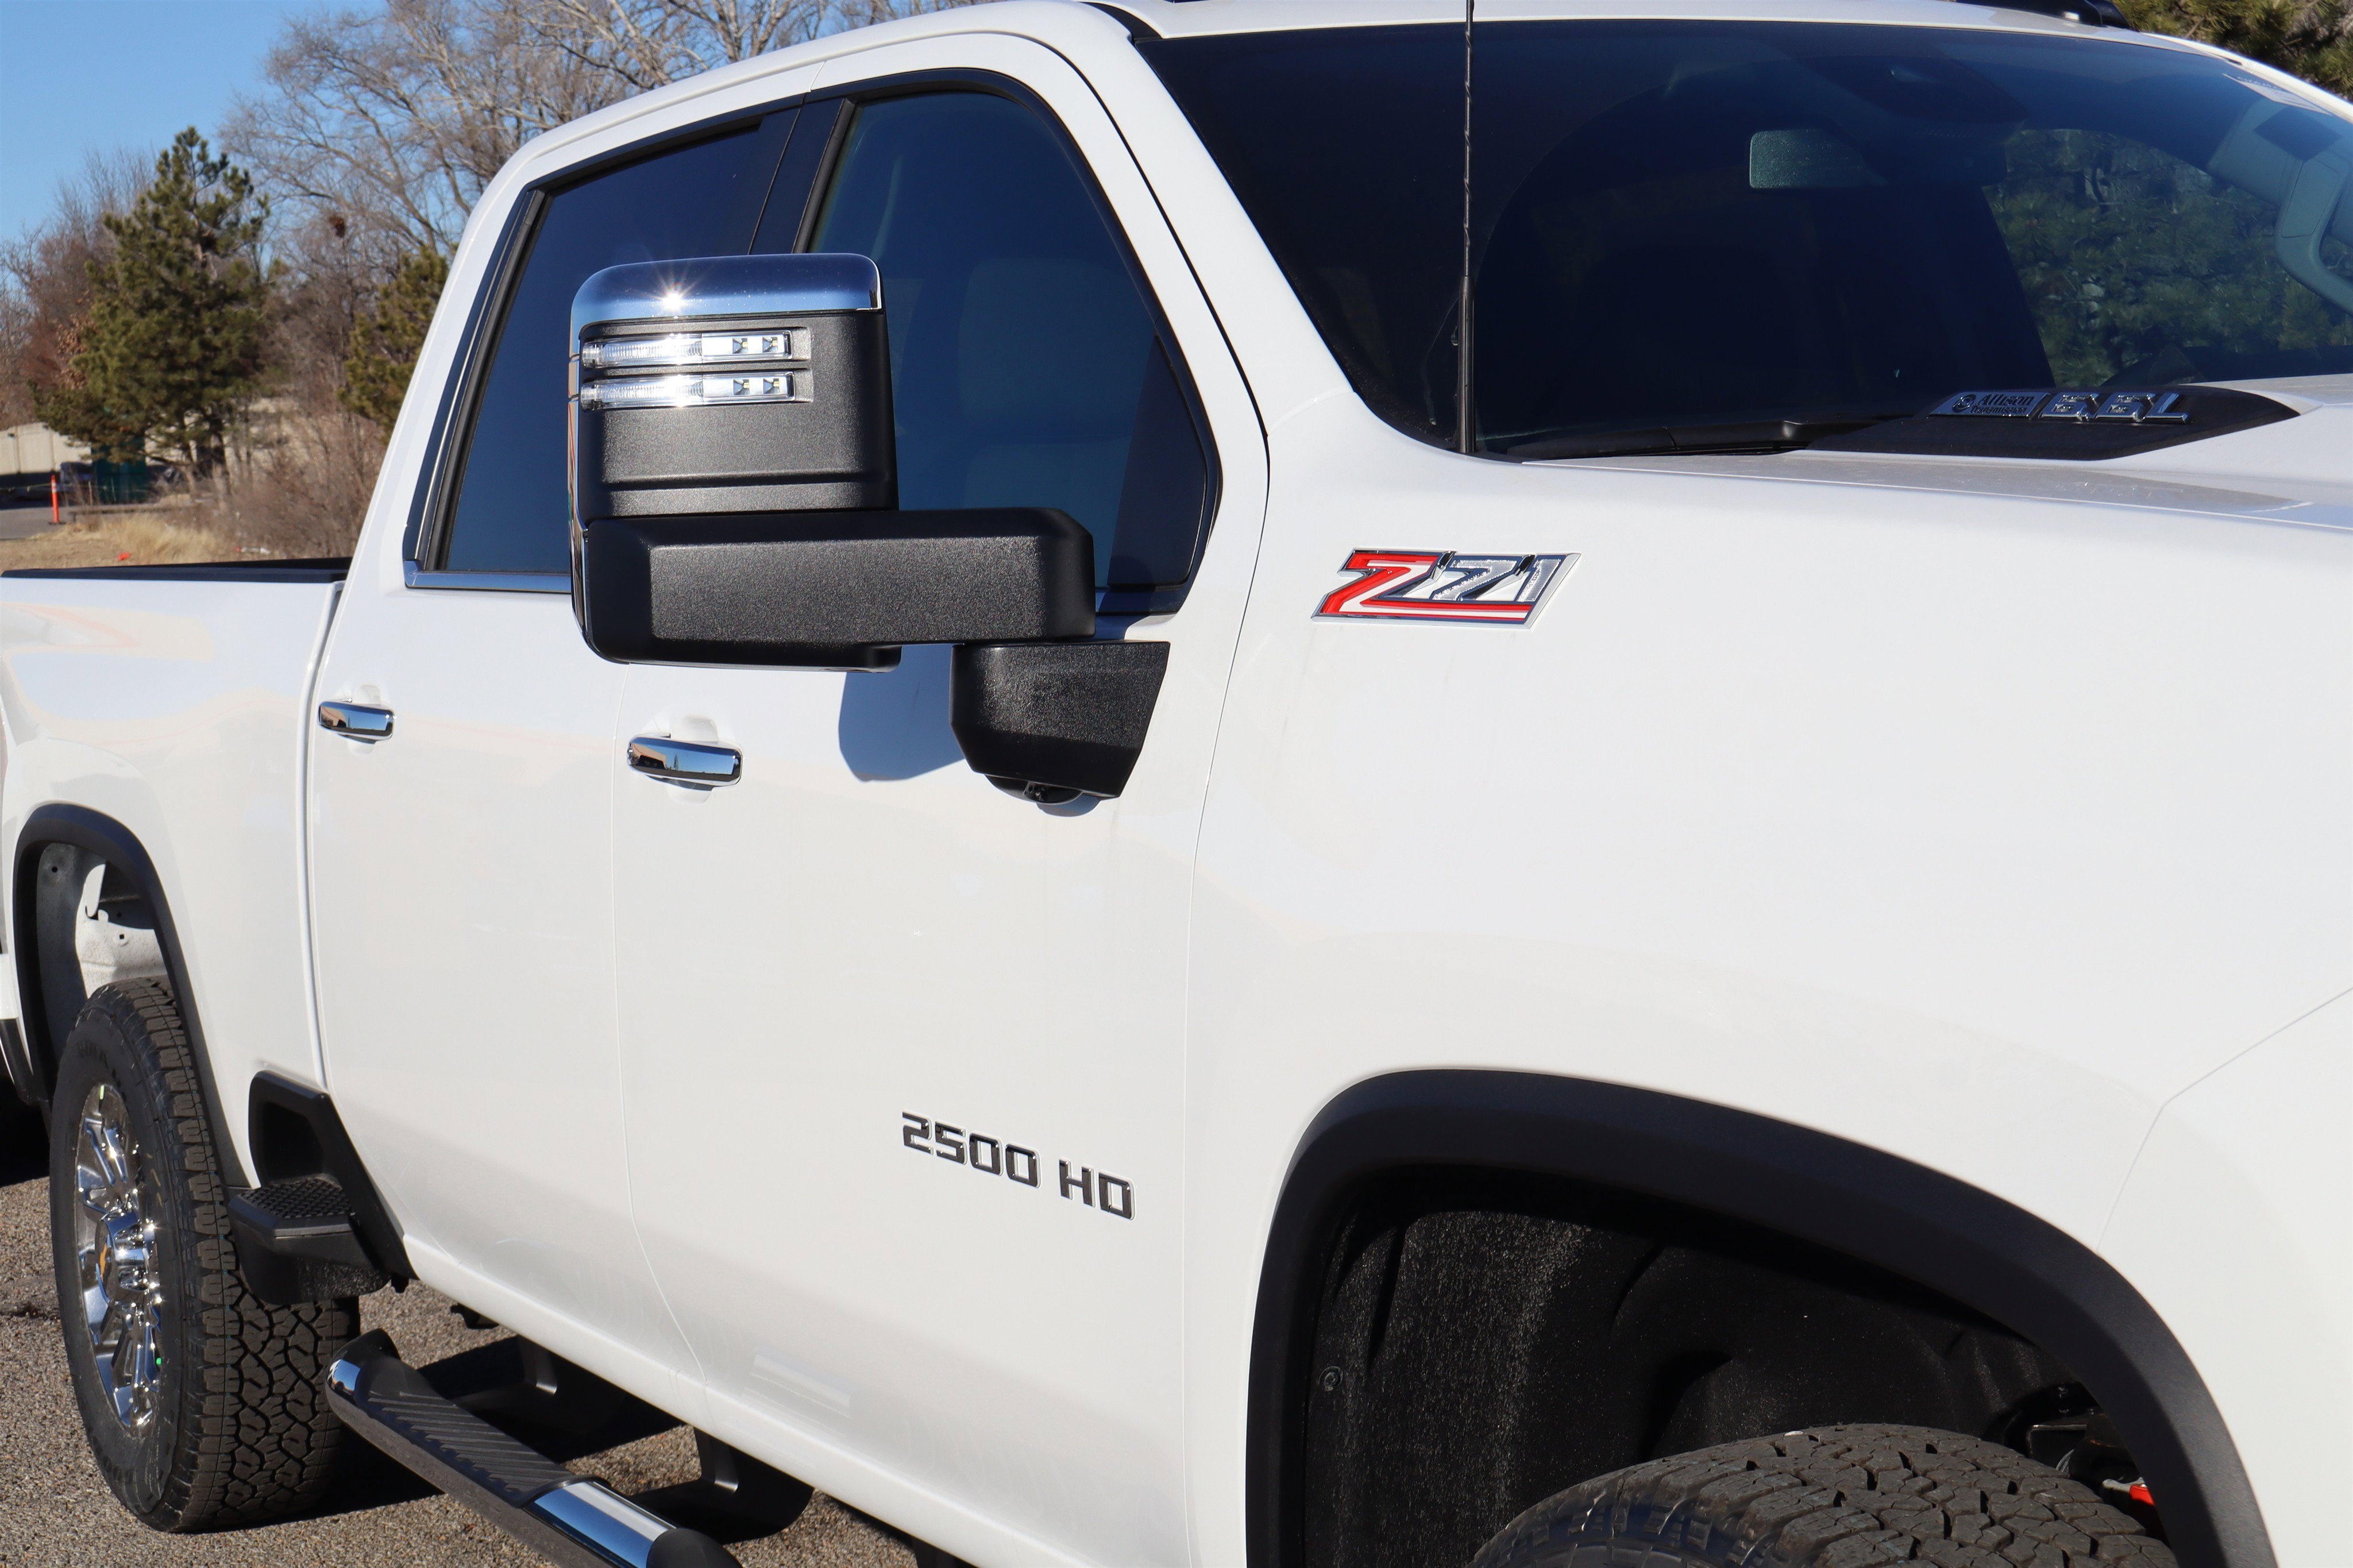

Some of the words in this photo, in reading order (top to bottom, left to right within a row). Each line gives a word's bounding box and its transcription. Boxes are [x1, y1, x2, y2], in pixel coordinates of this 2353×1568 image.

[1969, 405, 2027, 414] Transmission
[1976, 393, 2035, 406] Allison
[1310, 547, 1581, 629] Z71
[902, 1111, 1042, 1188] 2500
[1058, 1157, 1136, 1221] HD
